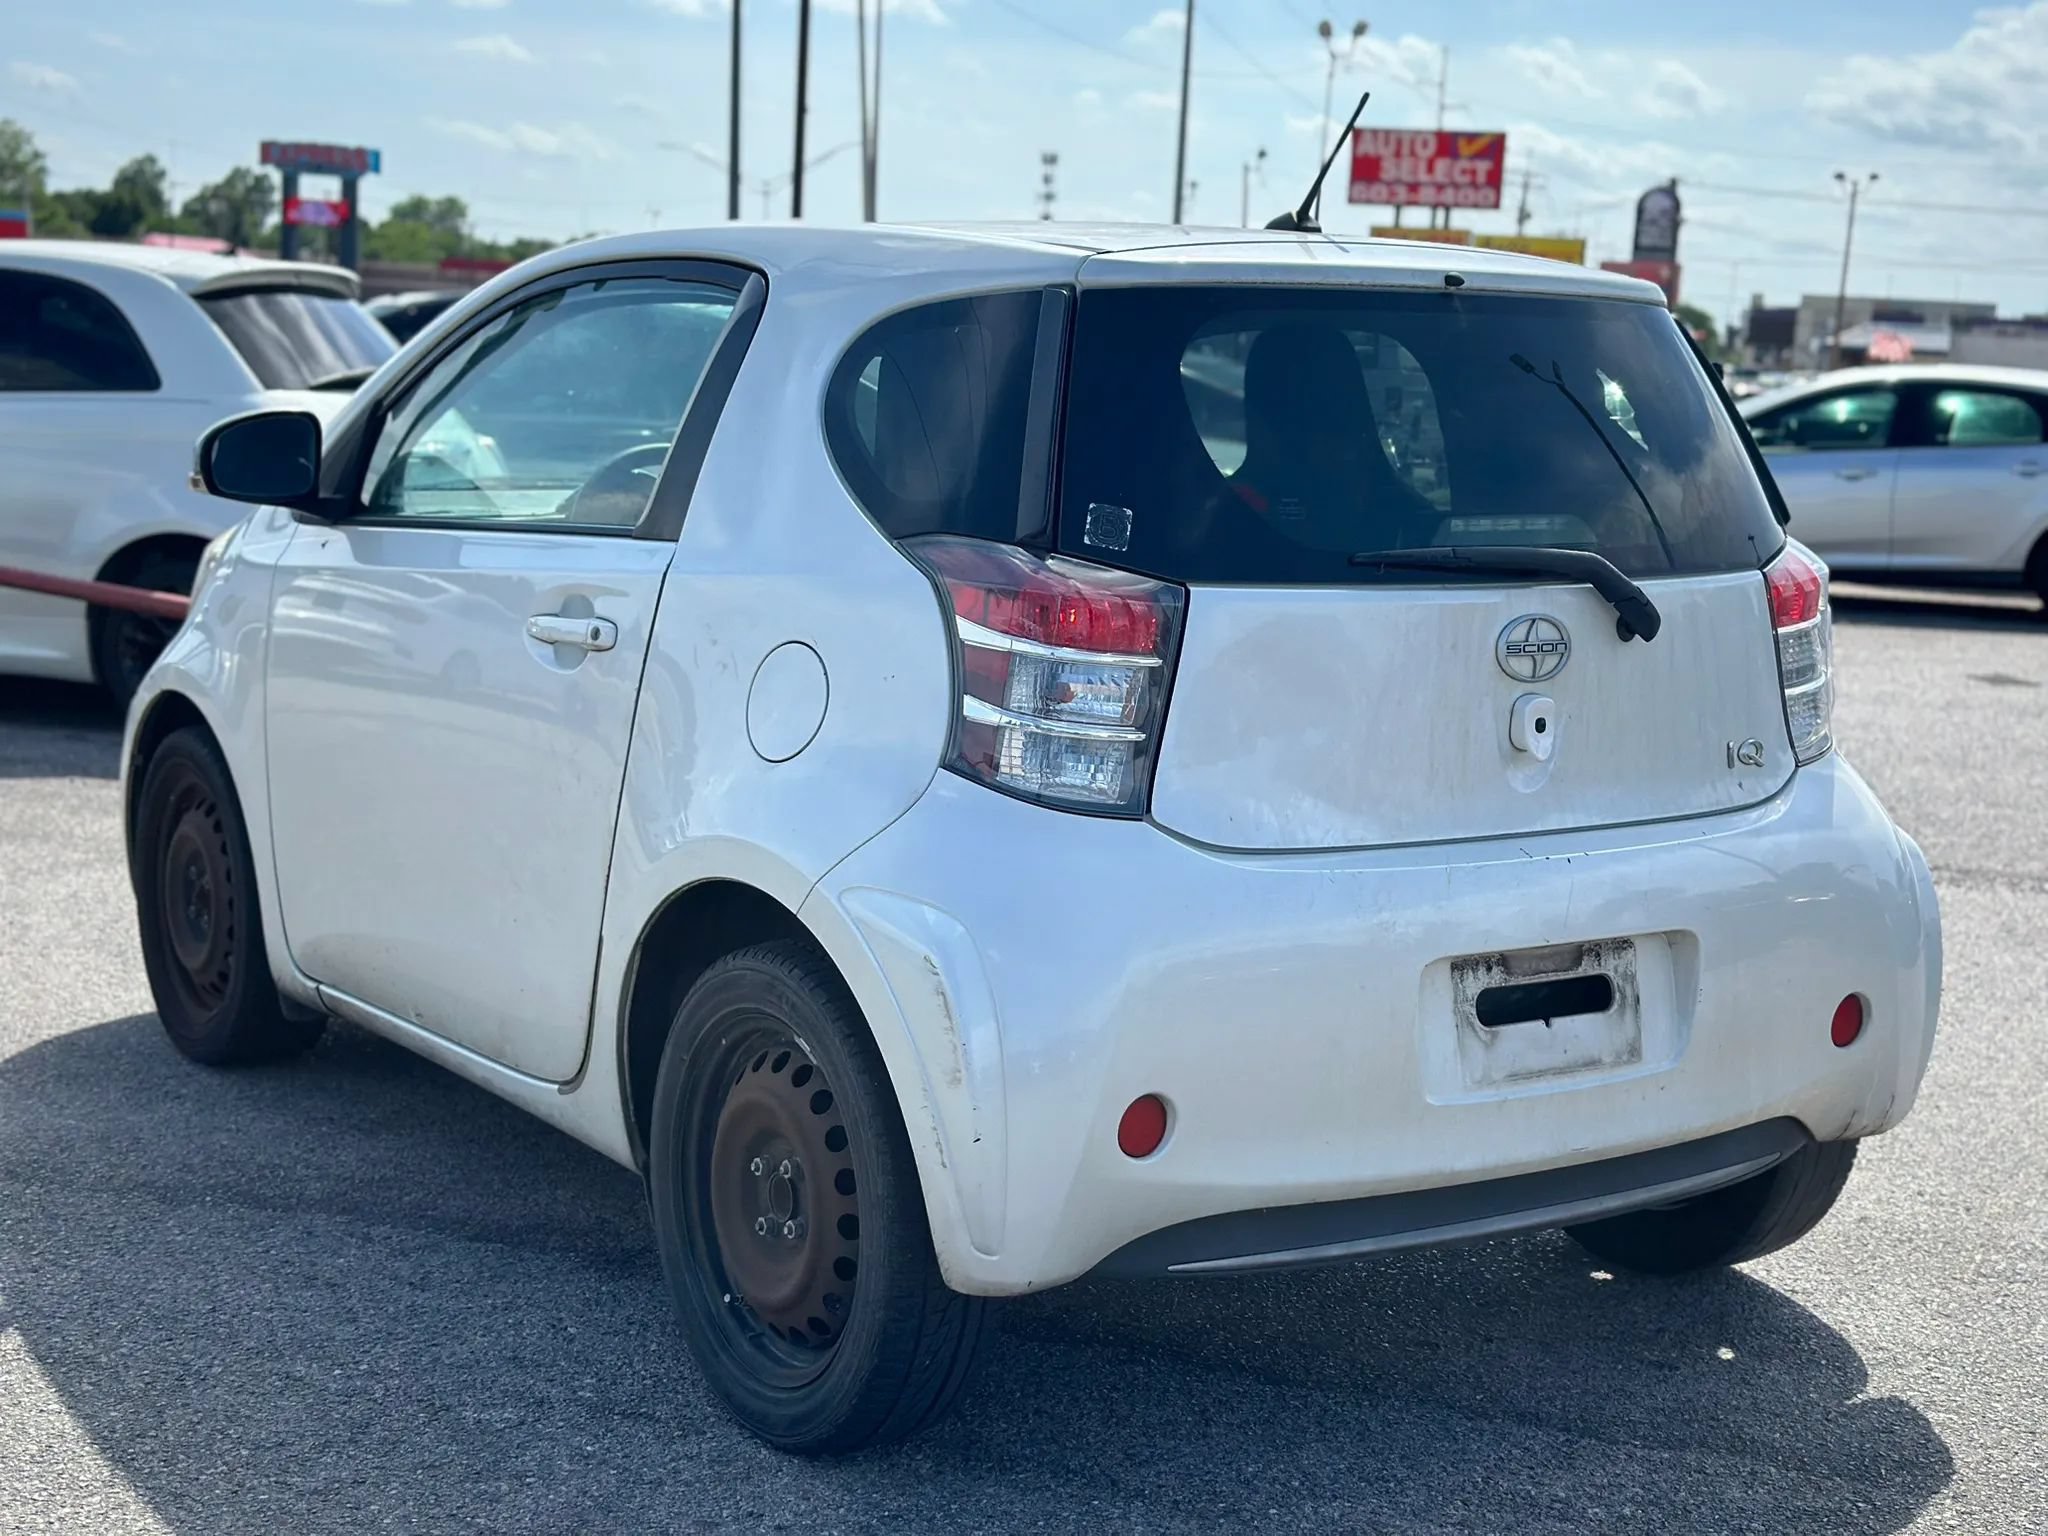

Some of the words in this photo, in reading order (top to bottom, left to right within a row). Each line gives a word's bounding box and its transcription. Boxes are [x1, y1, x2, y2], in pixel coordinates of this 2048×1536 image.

[1355, 131, 1437, 157] AUTO
[1379, 156, 1493, 184] SELECT
[1506, 642, 1568, 654] SCION
